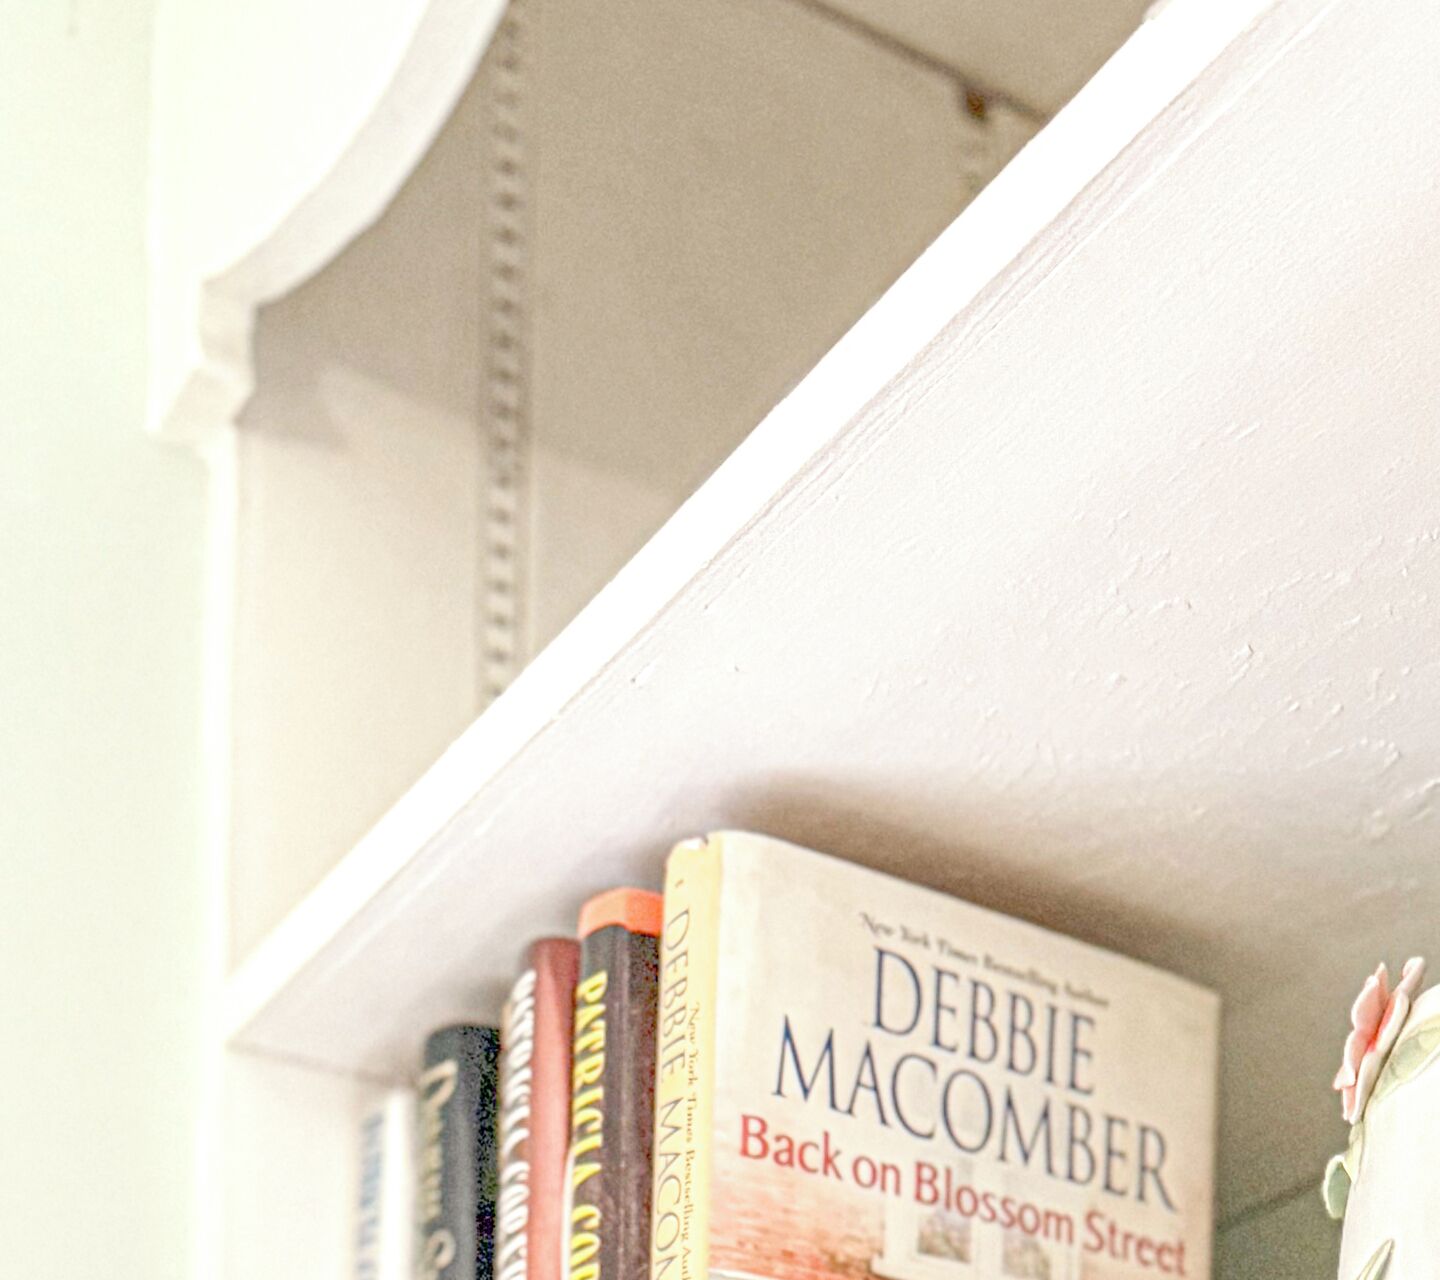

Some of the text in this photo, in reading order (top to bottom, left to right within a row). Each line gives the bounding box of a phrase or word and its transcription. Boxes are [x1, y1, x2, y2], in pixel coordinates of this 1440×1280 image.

[661, 908, 690, 1077] DEBBIE
[872, 945, 1097, 1097] DEBBIE
[738, 1113, 1188, 1277] Back on Blossom Street
[771, 1014, 1178, 1214] MACOMBER
